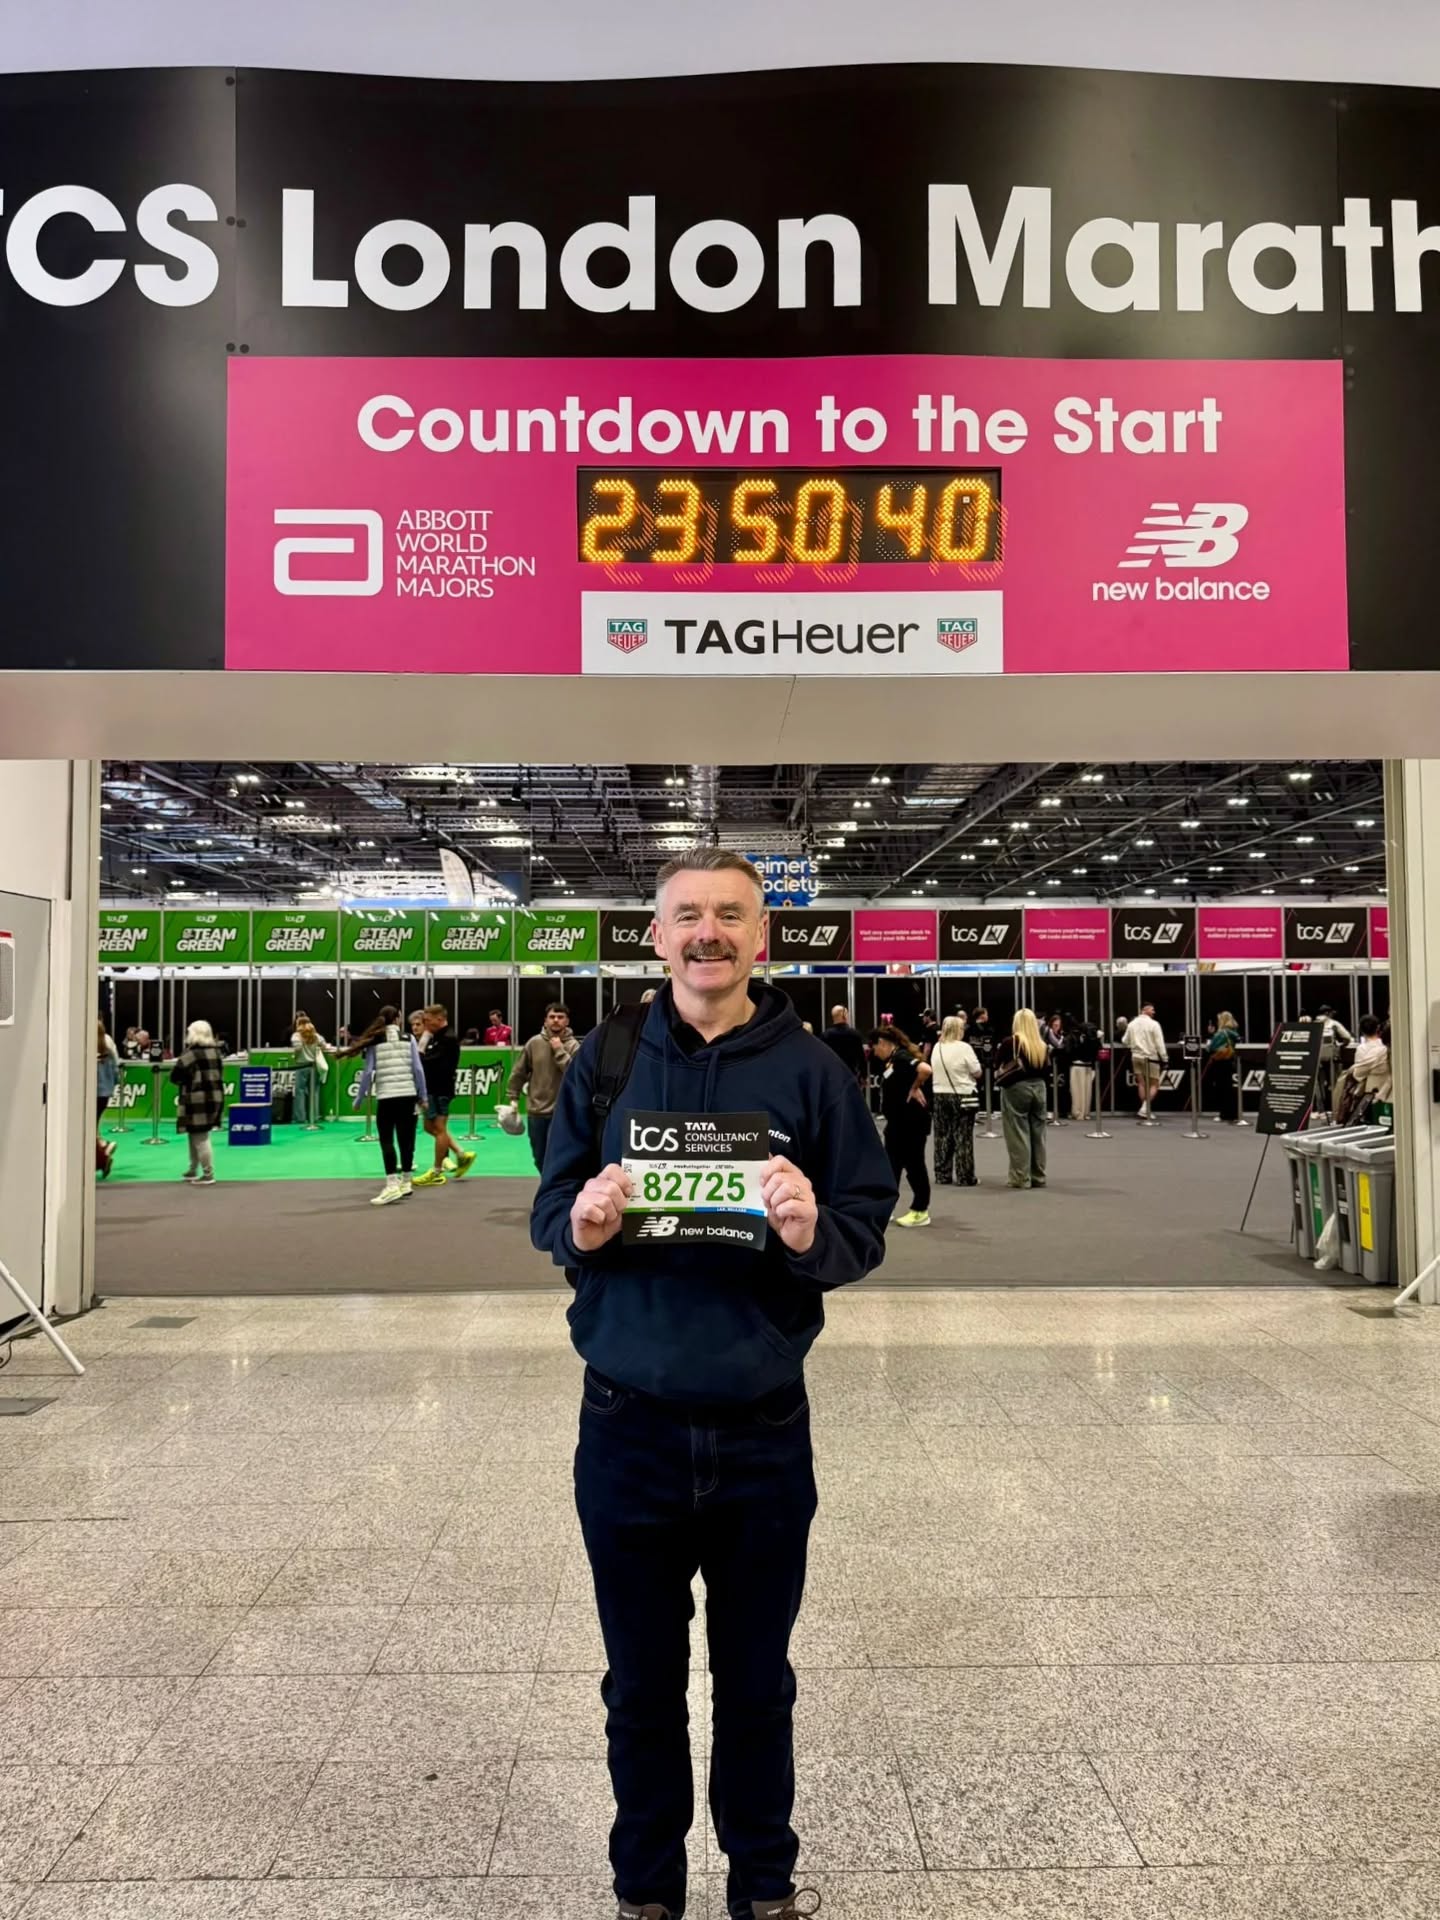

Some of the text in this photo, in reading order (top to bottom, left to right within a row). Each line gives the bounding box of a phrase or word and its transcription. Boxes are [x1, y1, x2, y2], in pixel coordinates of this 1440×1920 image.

[0, 184, 1440, 314] CS London Marath
[357, 394, 1222, 454] Countdown to the Start
[396, 510, 494, 530] ABBOTT
[583, 478, 990, 562] 23 50 40
[395, 532, 488, 553] WORLD
[396, 556, 536, 576] MARATHON
[396, 577, 494, 598] MAJORS
[1092, 576, 1271, 601] new balance
[611, 622, 643, 632] TAG
[941, 621, 973, 632] TAG
[609, 633, 645, 649] HEUER
[940, 633, 975, 649] HEUER
[104, 928, 148, 940] TEAM
[193, 928, 237, 940] TEAM
[282, 928, 326, 940] TEAM
[371, 927, 413, 939] TEAM
[457, 927, 500, 939] TEAM
[544, 927, 586, 939] TEAM
[612, 925, 639, 943] tcs
[782, 925, 809, 943] tcs
[952, 925, 978, 942] tcs
[1124, 923, 1152, 940] tcs
[1296, 922, 1324, 940] tcs
[176, 939, 225, 951] GREEN
[265, 939, 314, 951] GREEN
[353, 938, 402, 950] GREEN
[441, 938, 489, 950] GREEN
[527, 938, 574, 950] GREEN
[684, 1122, 717, 1131] TATA
[630, 1118, 679, 1152] tcs
[685, 1132, 759, 1142] CONSULTANCY
[685, 1143, 732, 1153] SERVICES
[643, 1172, 746, 1202] 82725
[680, 1225, 754, 1241] new balance
